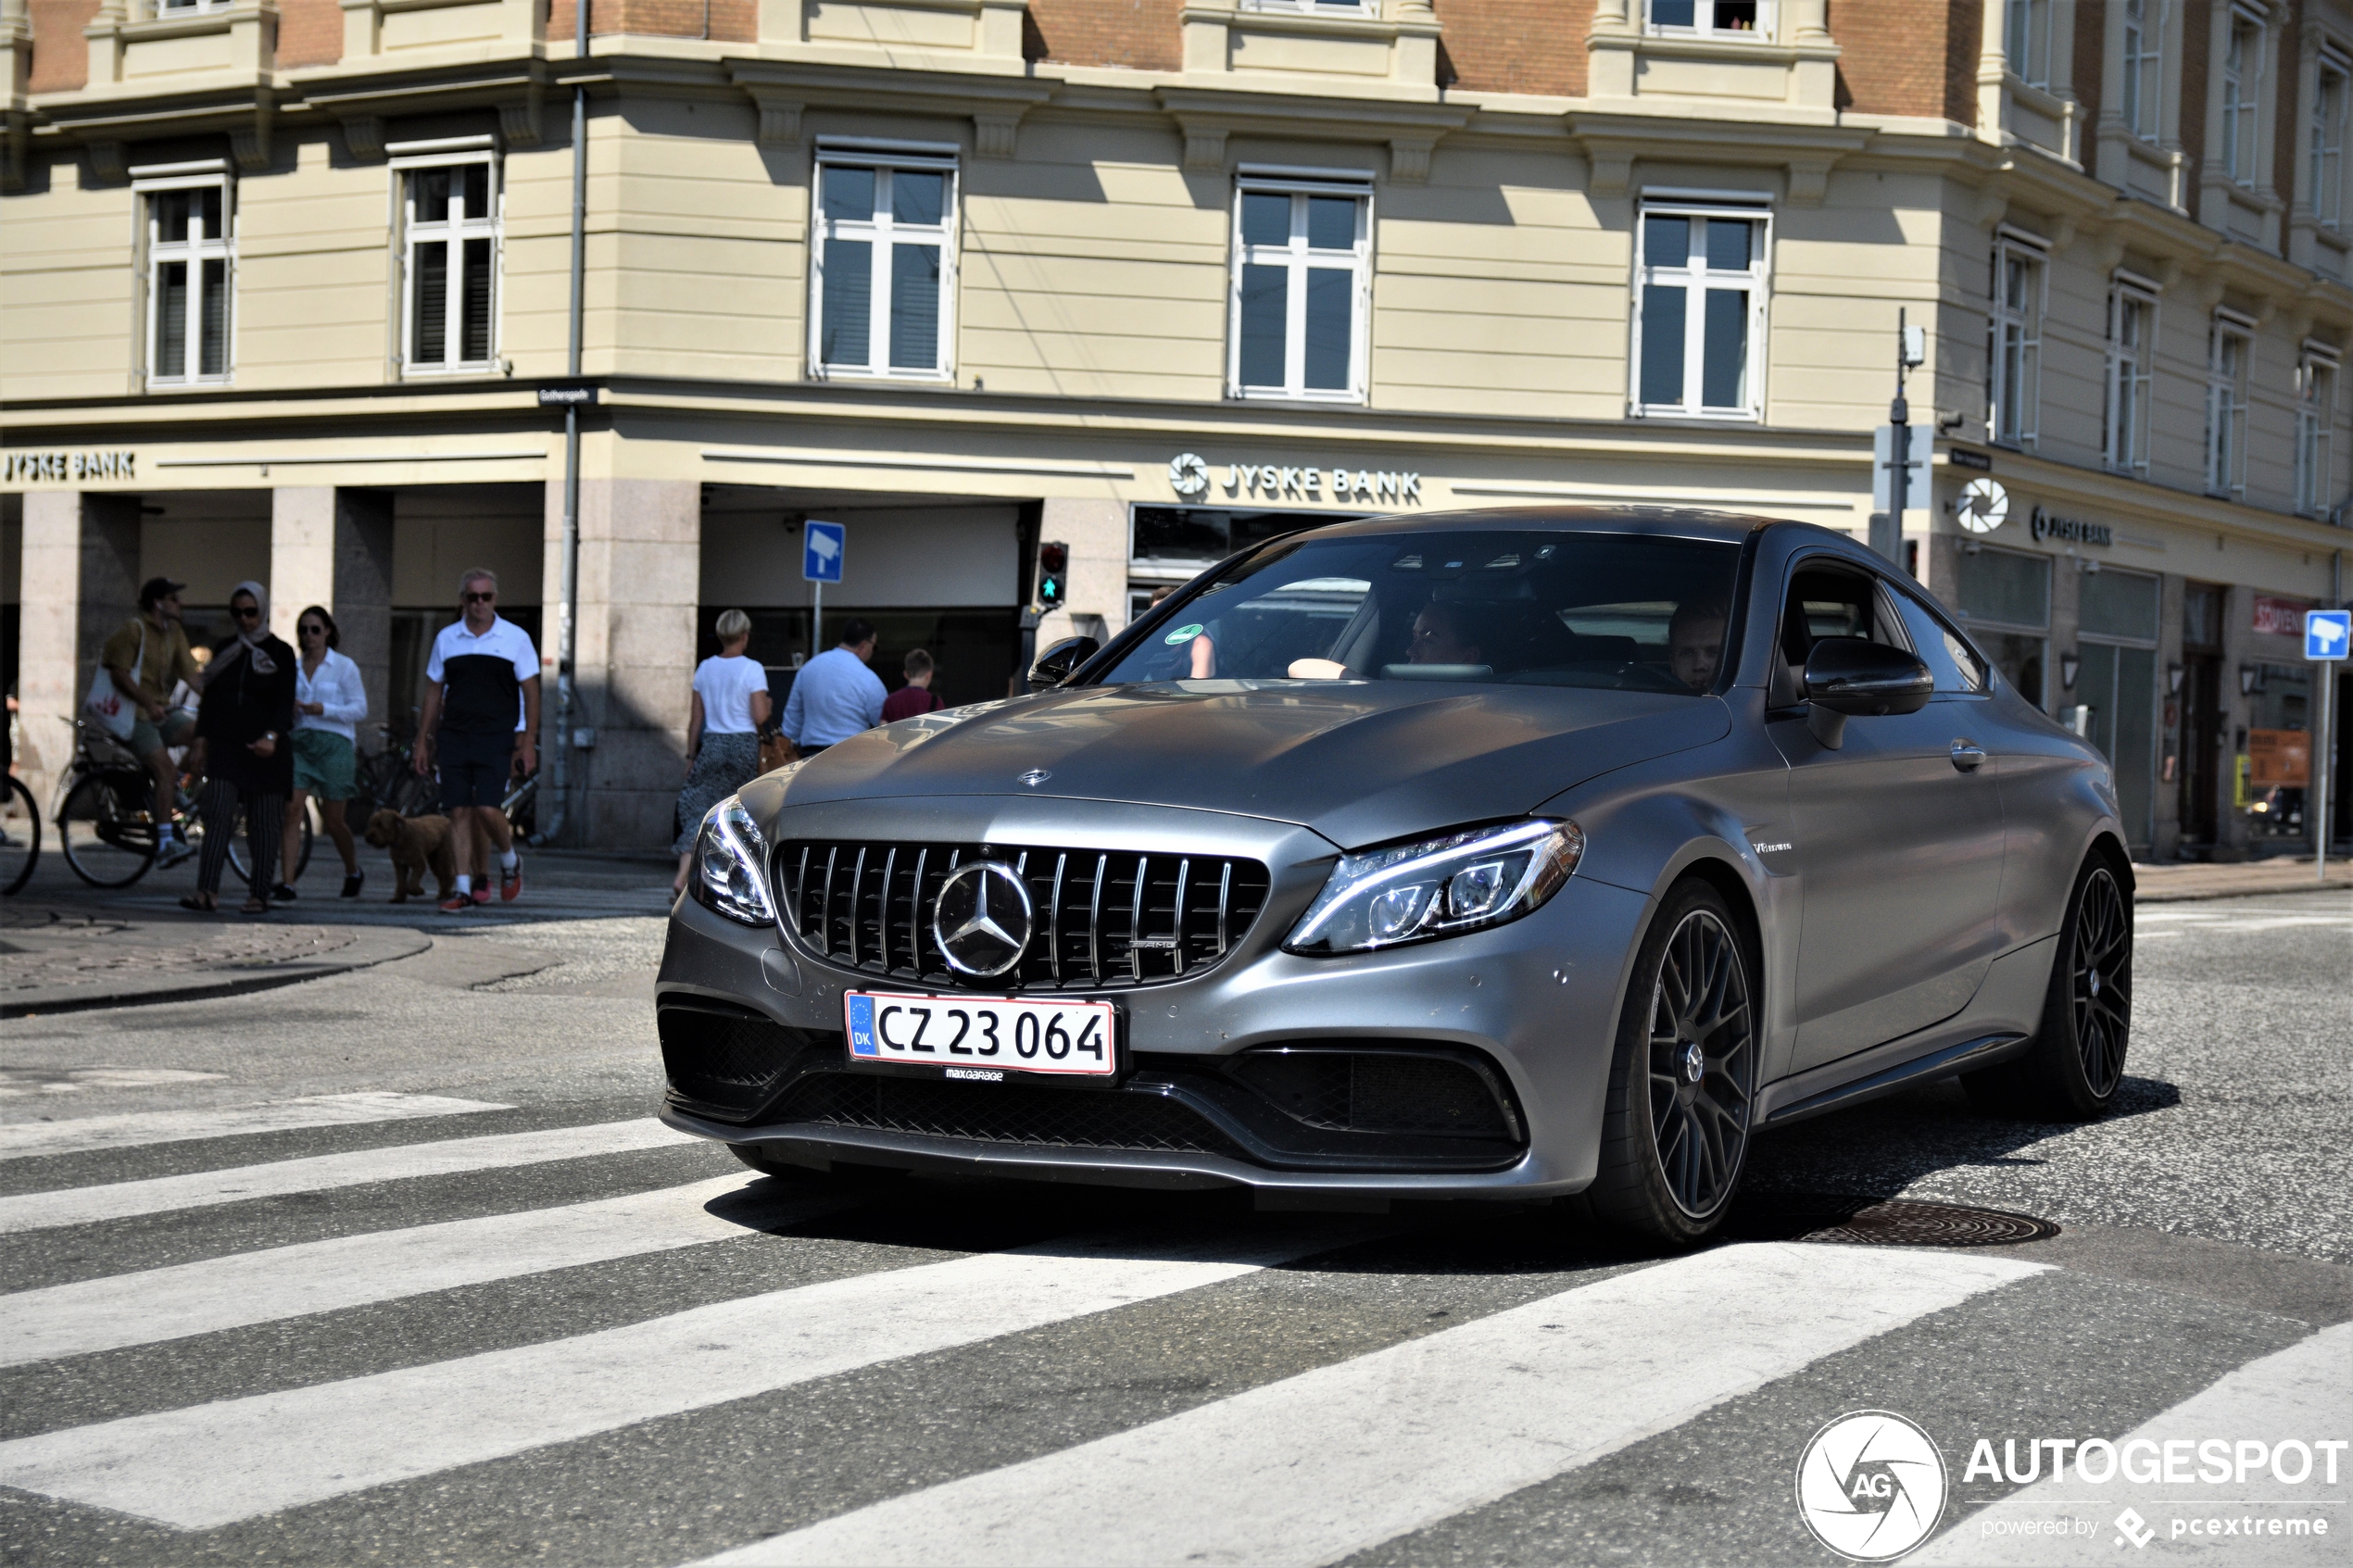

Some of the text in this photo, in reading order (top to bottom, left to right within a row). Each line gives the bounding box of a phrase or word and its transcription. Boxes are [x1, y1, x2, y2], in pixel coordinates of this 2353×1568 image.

[539, 389, 589, 402] Gothersgade
[5, 451, 134, 480] JYSKE BANK
[1221, 463, 1420, 495] JYSKE BANK
[854, 1032, 872, 1047] DK
[878, 1006, 1104, 1061] CZ 23 064
